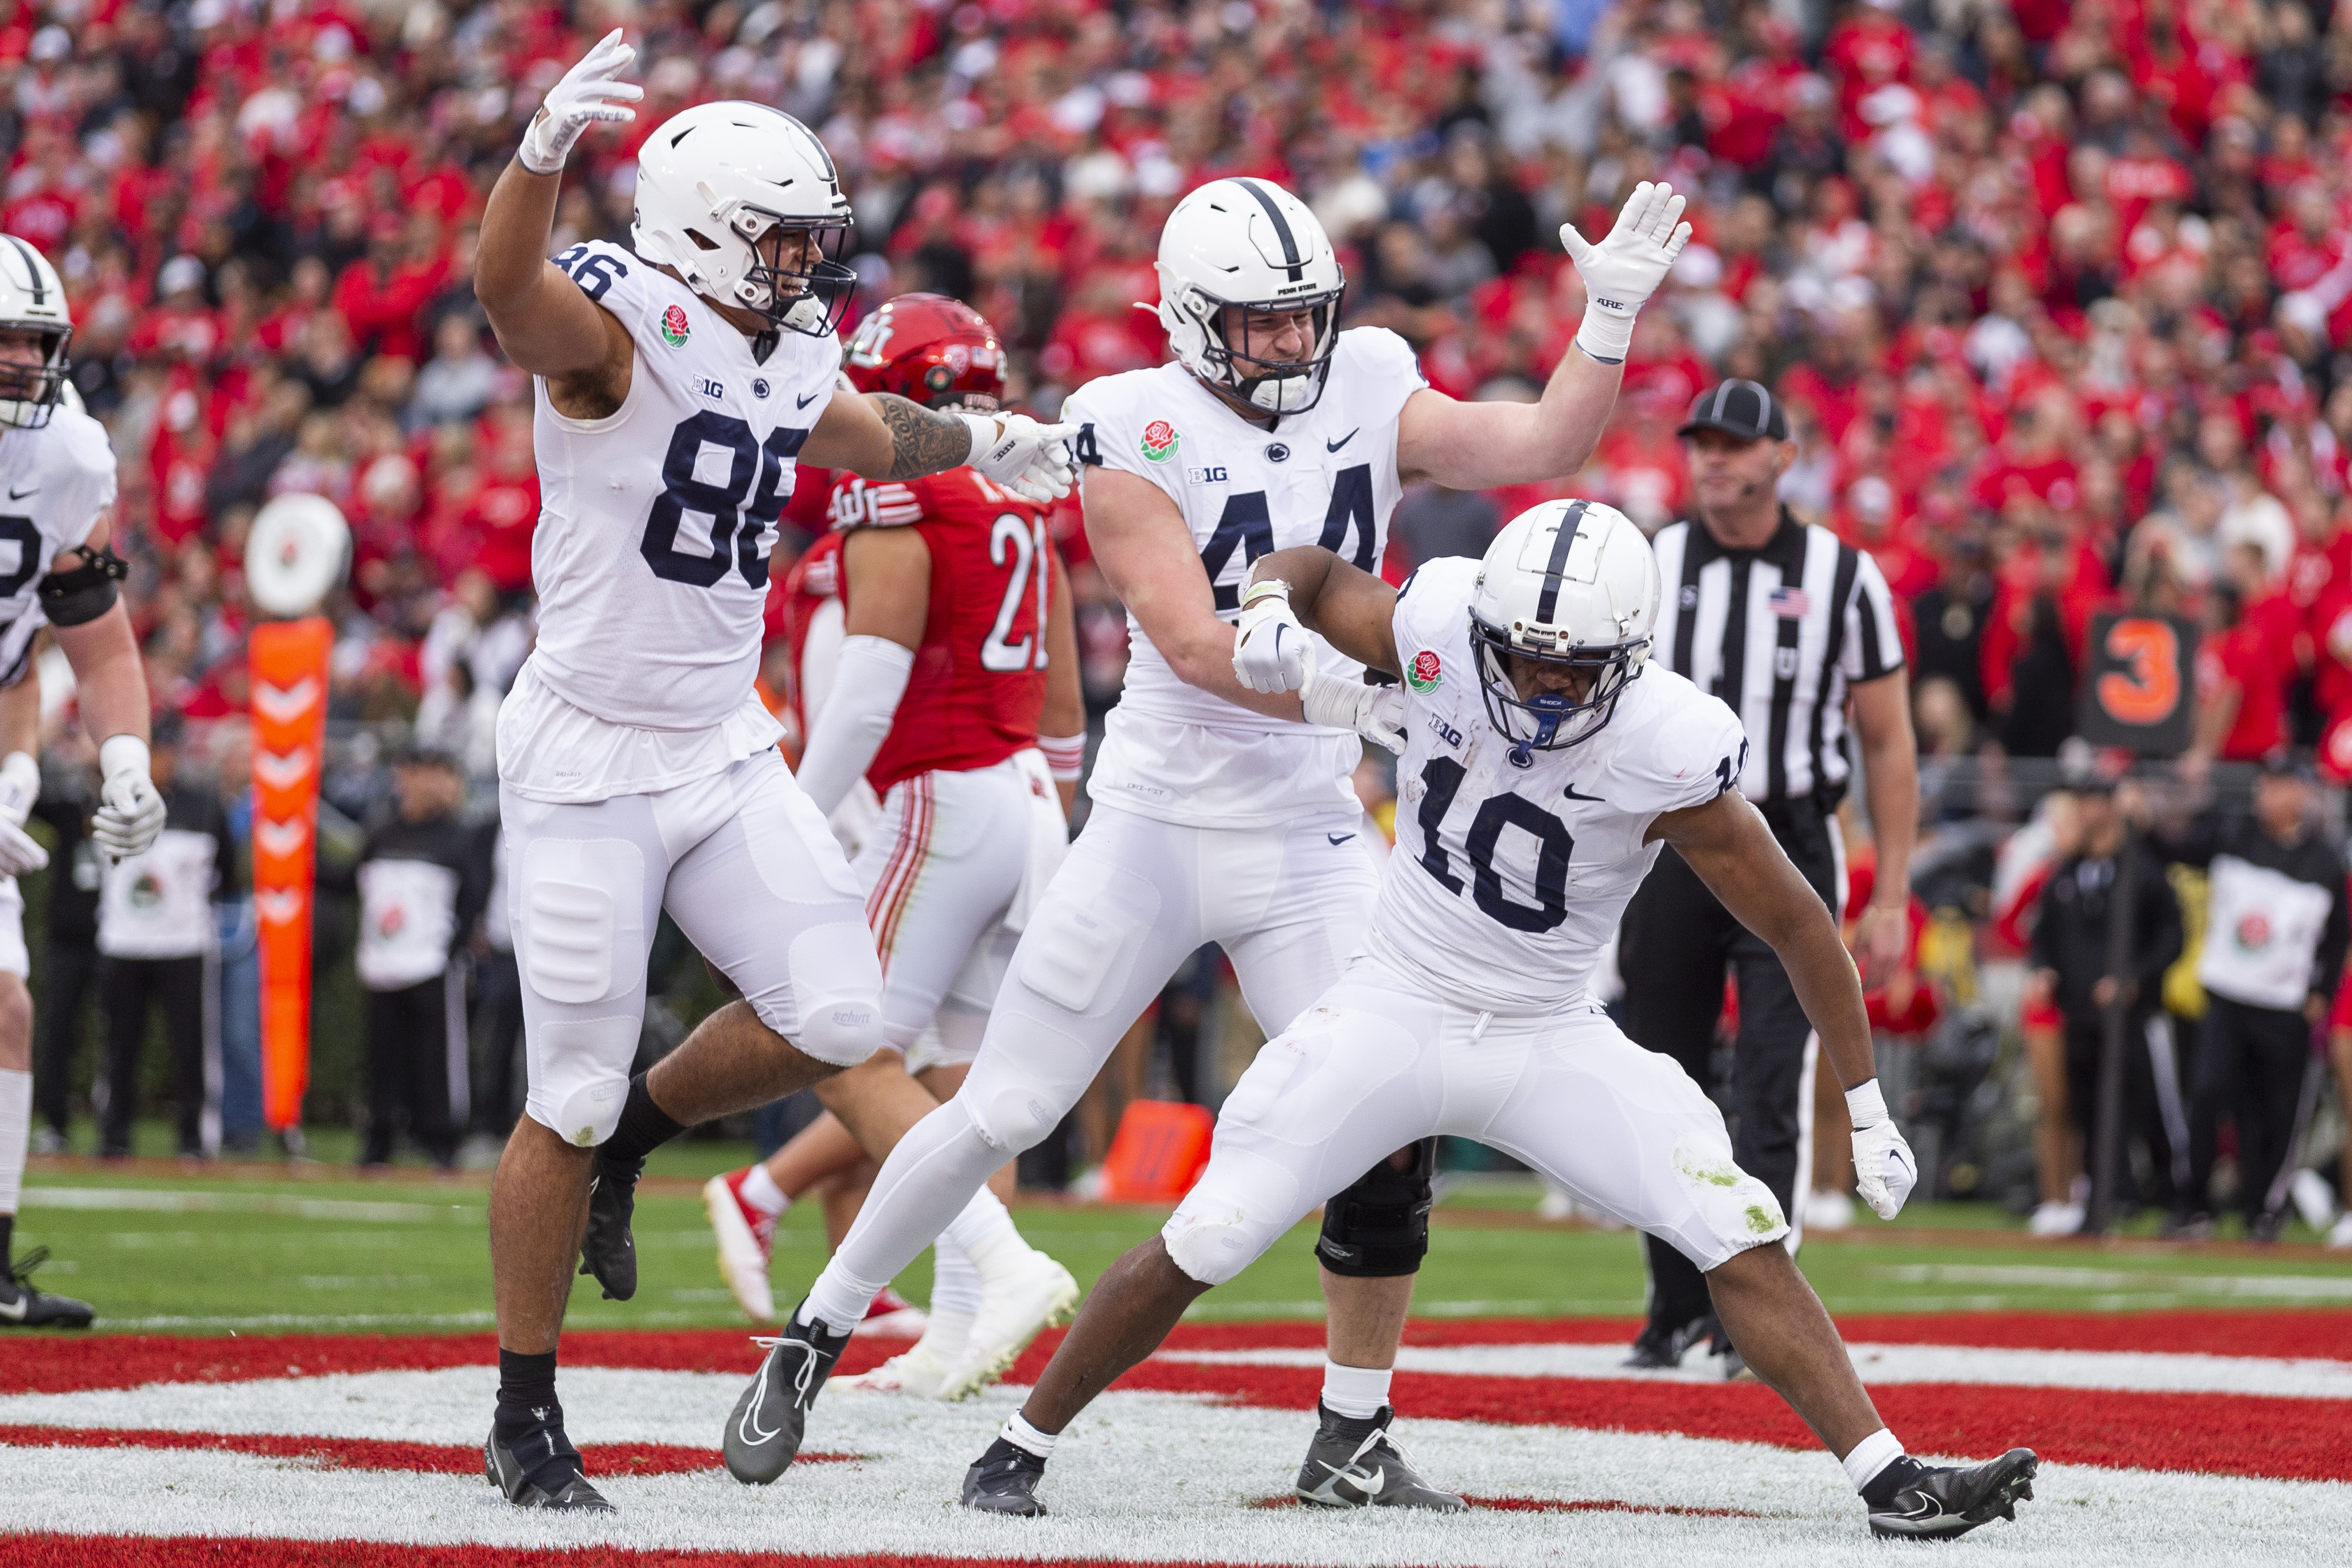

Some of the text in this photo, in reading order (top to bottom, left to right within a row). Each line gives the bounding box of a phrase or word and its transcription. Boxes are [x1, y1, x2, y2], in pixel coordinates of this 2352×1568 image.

[1278, 287, 1296, 295] PENN
[1597, 298, 1624, 310] ARE
[691, 374, 724, 399] BIG
[1188, 467, 1228, 484] BIG
[980, 512, 1049, 671] 21
[2097, 617, 2181, 725] 3
[1428, 711, 1463, 748] BIG
[1414, 755, 1576, 934] 10
